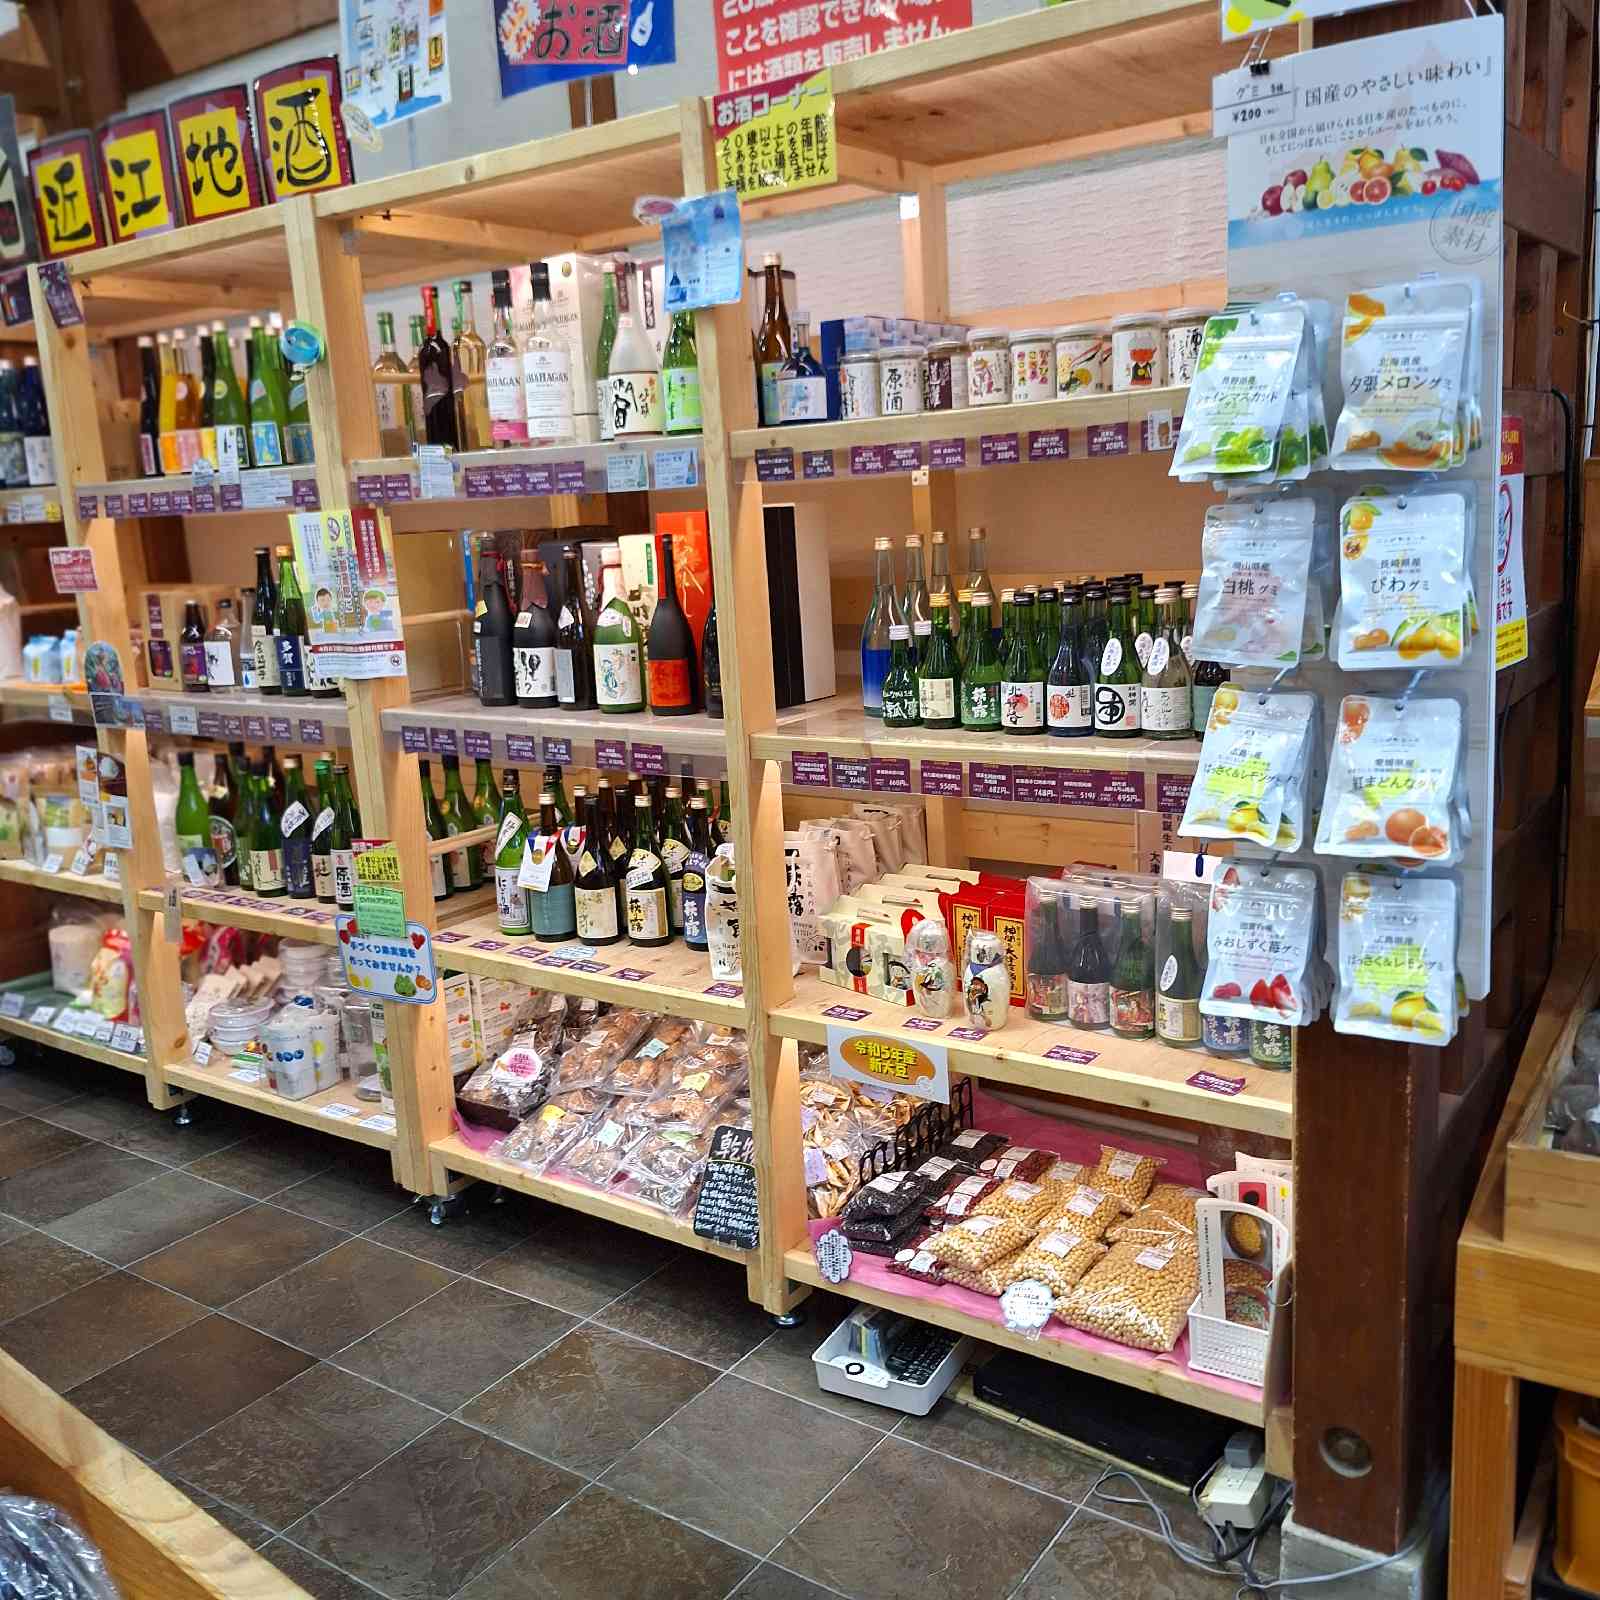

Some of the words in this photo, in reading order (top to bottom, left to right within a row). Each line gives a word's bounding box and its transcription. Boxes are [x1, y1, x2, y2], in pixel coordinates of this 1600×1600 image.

[533, 2, 625, 60] お酒
[1304, 57, 1492, 108] 国産のやさしい味わい」
[716, 83, 827, 127] お酒コーナー
[1232, 107, 1262, 123] ¥200
[110, 157, 161, 228] 江
[185, 125, 243, 198] 地
[1378, 355, 1421, 368] 北海道産
[1350, 374, 1454, 393] 夕張メロングミ
[1378, 556, 1421, 569] 長崎県産
[1371, 576, 1430, 594] びわグミ
[281, 640, 294, 665] 多賀
[854, 1039, 919, 1066] 令和5年産
[869, 1057, 910, 1079] 新大豆
